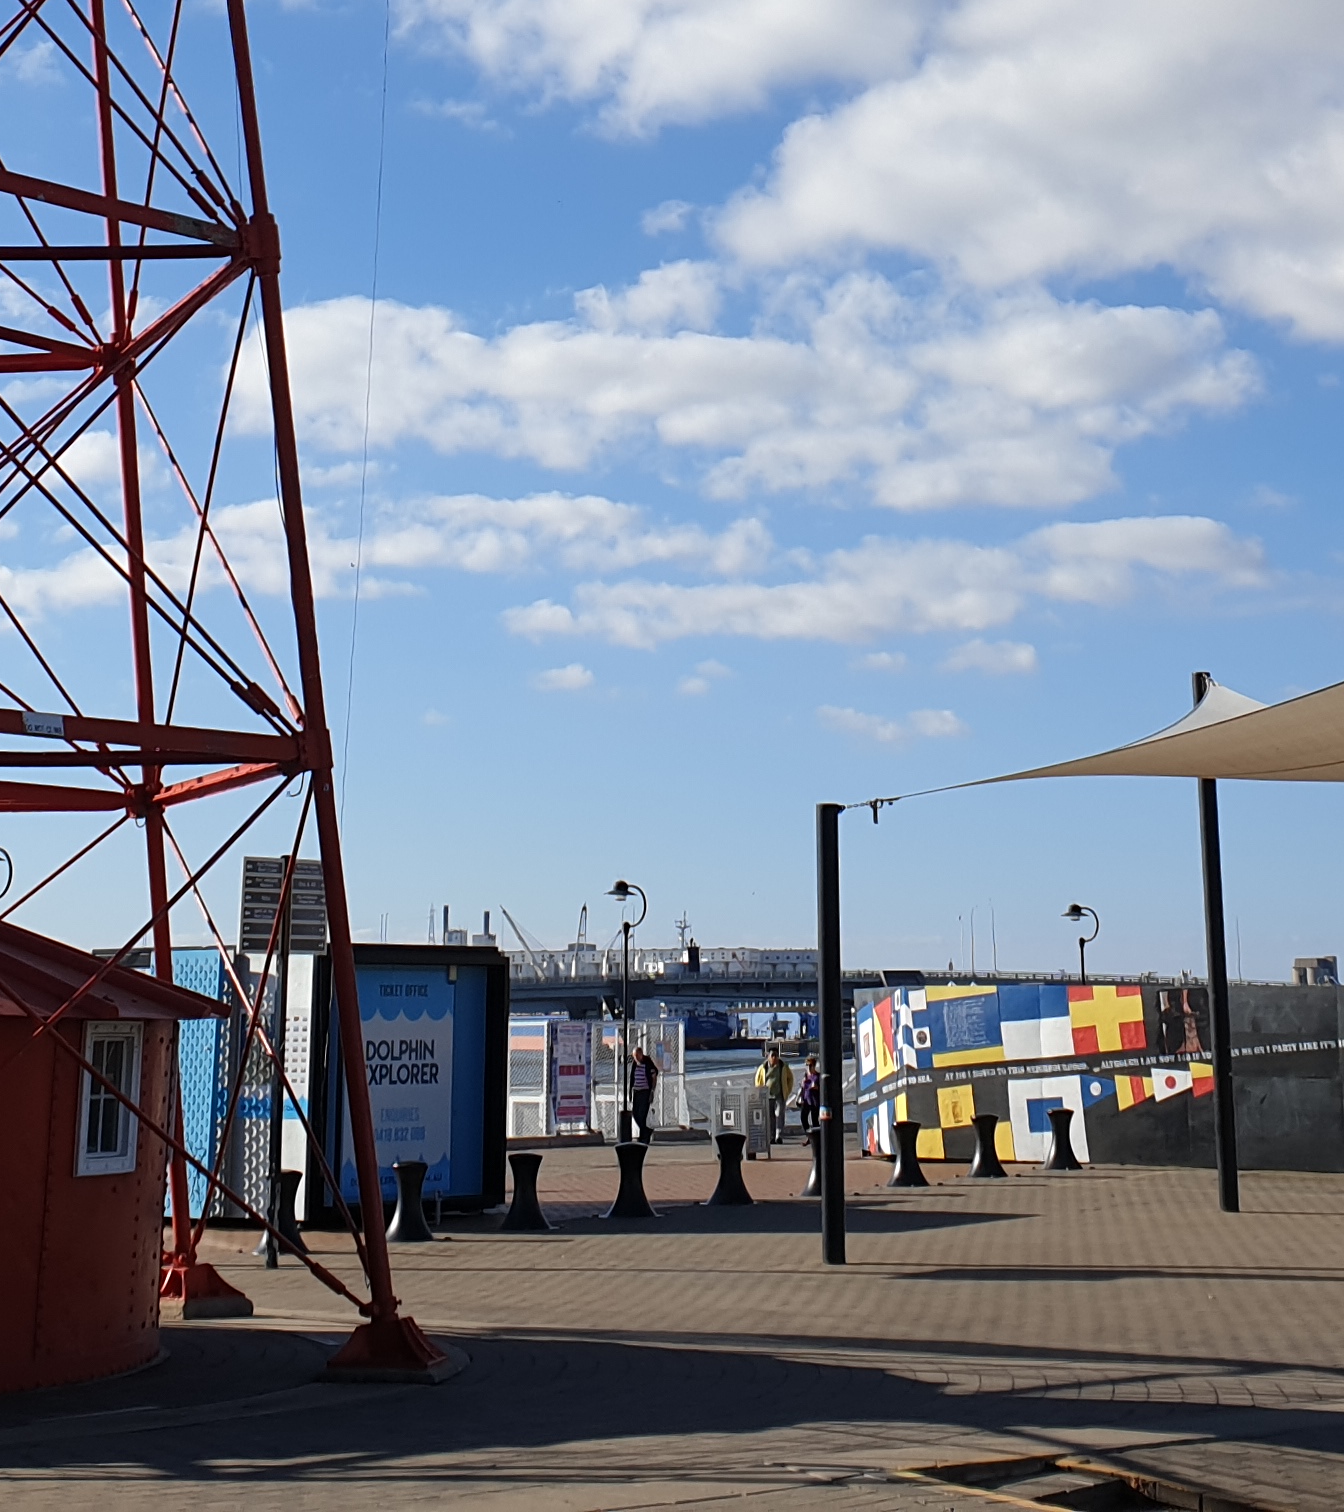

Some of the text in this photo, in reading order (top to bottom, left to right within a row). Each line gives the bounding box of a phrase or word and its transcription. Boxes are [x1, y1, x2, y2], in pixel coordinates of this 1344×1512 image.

[379, 984, 429, 997] TICKET OFFICE
[366, 1039, 434, 1062] DOLPHIN
[996, 1067, 1007, 1076] TO
[1202, 1051, 1213, 1061] YO
[1272, 1043, 1297, 1053] PARTY
[1298, 1041, 1318, 1051] LIKE
[365, 1062, 439, 1086] XPLORER
